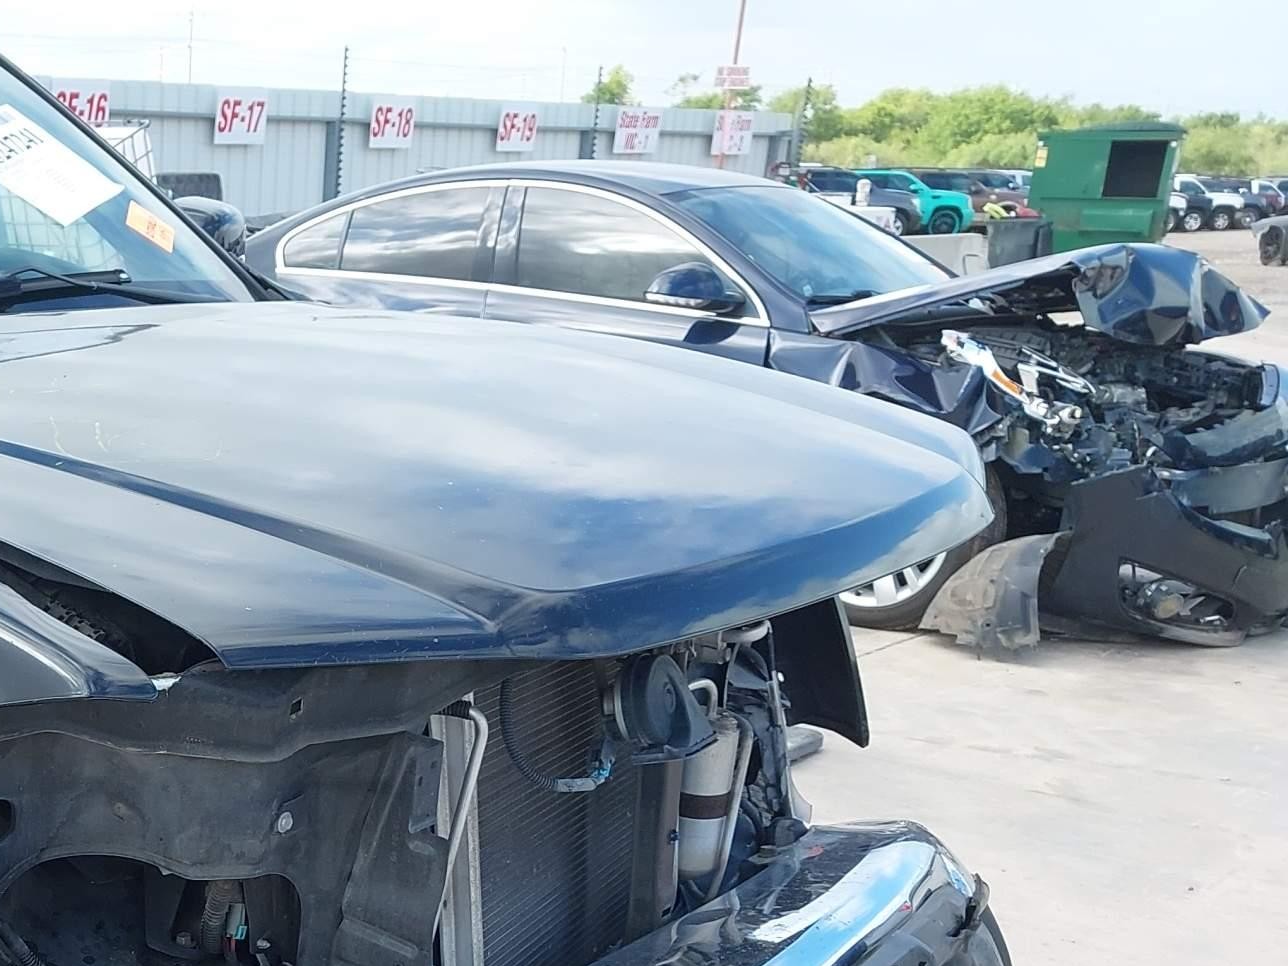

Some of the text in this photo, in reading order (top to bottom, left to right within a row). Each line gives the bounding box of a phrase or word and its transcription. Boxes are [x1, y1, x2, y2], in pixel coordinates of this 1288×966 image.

[217, 99, 265, 133] SF-17
[372, 106, 414, 139] SF-18
[499, 112, 537, 142] SF-19
